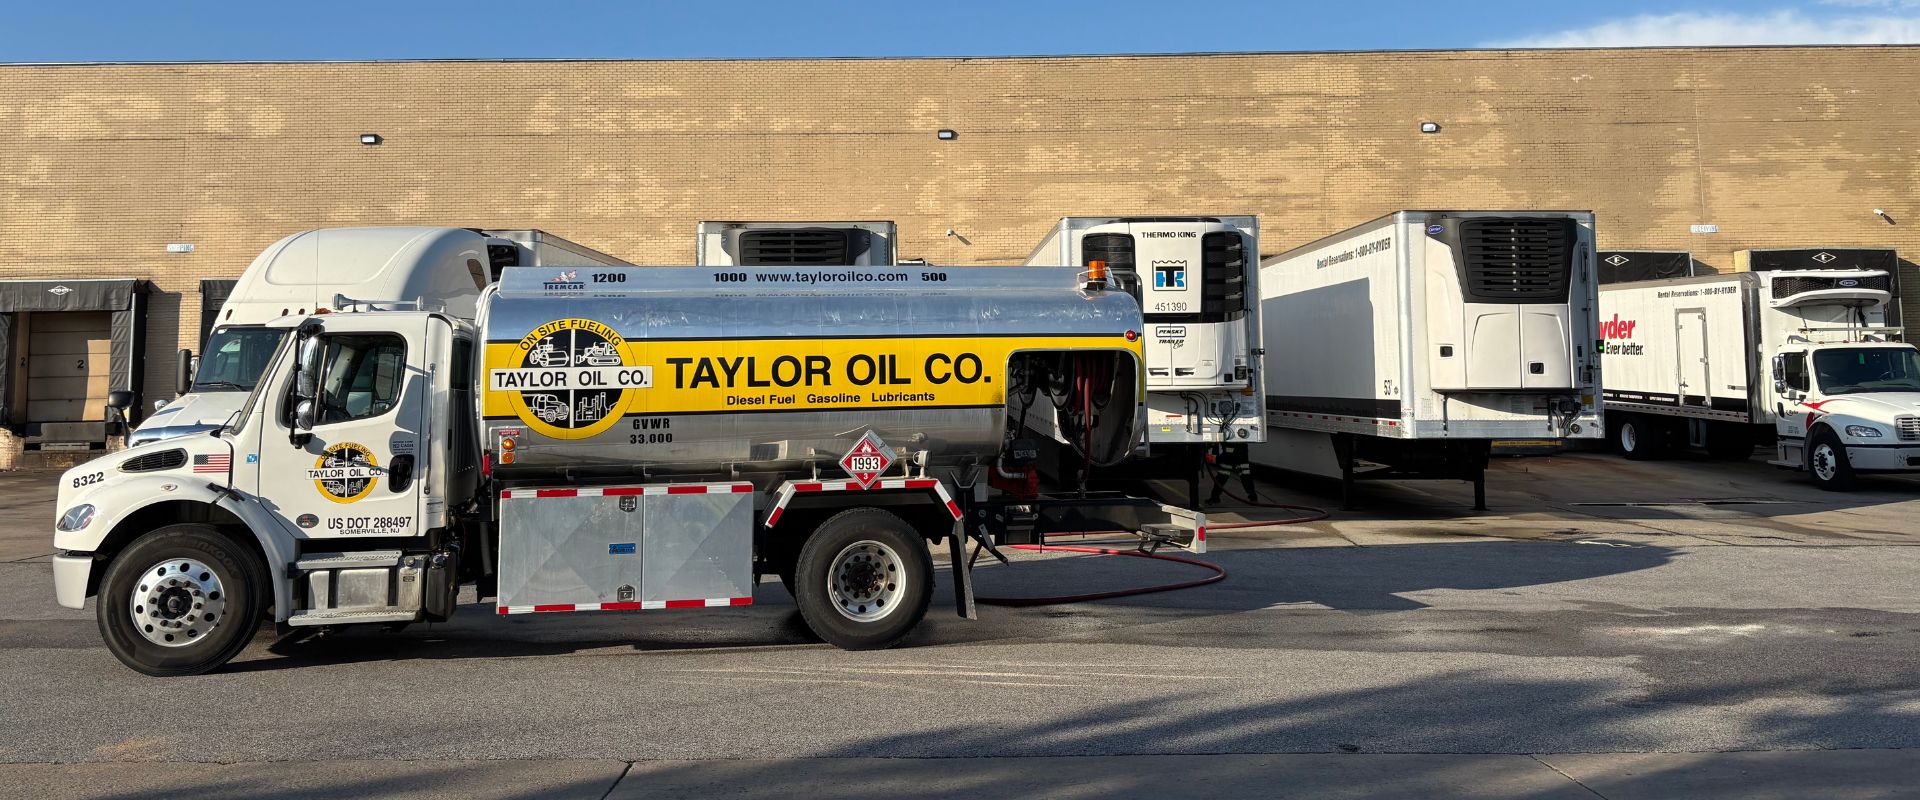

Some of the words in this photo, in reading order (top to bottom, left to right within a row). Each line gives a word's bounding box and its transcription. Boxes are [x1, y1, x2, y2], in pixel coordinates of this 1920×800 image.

[592, 273, 626, 283] 1200
[713, 272, 748, 282] 1000
[755, 271, 908, 285] www.tayloroilco.com
[921, 272, 947, 282] 500
[543, 282, 584, 290] TREMCAR
[1155, 302, 1187, 312] 451390
[1600, 313, 1636, 340] yder
[520, 334, 539, 351] ON
[538, 320, 566, 337] SITE
[570, 319, 622, 347] FUELING
[1606, 342, 1621, 355] Ever
[1622, 341, 1643, 356] better.
[77, 359, 85, 369] 2
[666, 355, 832, 390] TAYLOR
[846, 354, 912, 386] OIL
[924, 352, 992, 385] CO.
[494, 372, 567, 388] TAYLOR
[578, 371, 607, 386] OIL
[618, 370, 647, 385] CO.
[726, 394, 765, 406] Diesel
[769, 394, 796, 405] Fuel
[806, 393, 861, 404] Gasoline
[871, 391, 935, 403] Lubricants
[632, 418, 670, 430] GVWR
[629, 433, 673, 445] 33,000
[329, 443, 343, 453] SITE
[345, 442, 371, 457] FUELING
[853, 457, 879, 470] 1993
[72, 471, 105, 488] 8322
[308, 469, 344, 478] TAYLOR
[349, 468, 364, 477] OIL
[368, 468, 384, 477] CO.
[328, 518, 343, 529] US
[347, 517, 371, 529] DOT
[374, 516, 411, 528] 288497
